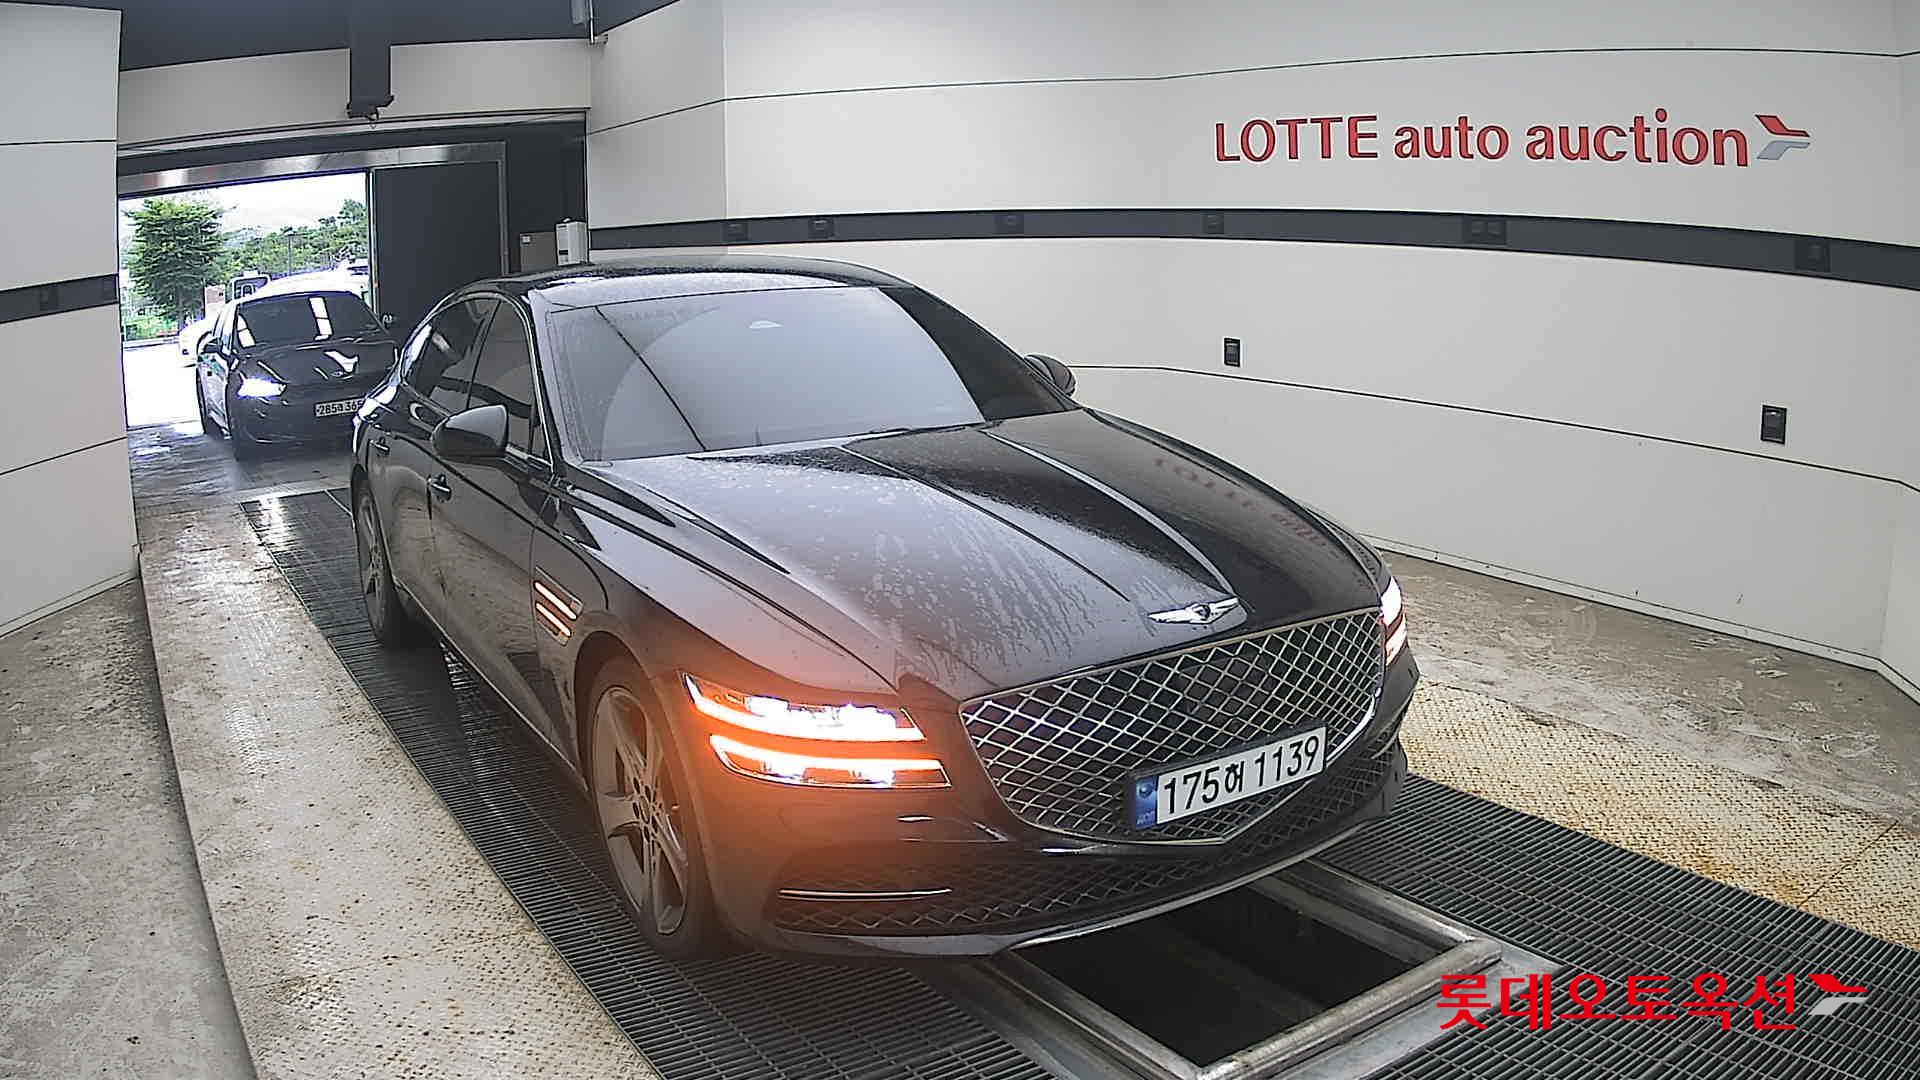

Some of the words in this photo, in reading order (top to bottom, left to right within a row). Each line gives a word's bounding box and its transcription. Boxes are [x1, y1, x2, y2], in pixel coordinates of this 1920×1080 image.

[1215, 115, 1378, 162] LOTTE
[1395, 116, 1508, 159] auto
[1526, 108, 1748, 167] auction
[1164, 761, 1244, 813] 175허
[1255, 735, 1319, 786] 1139
